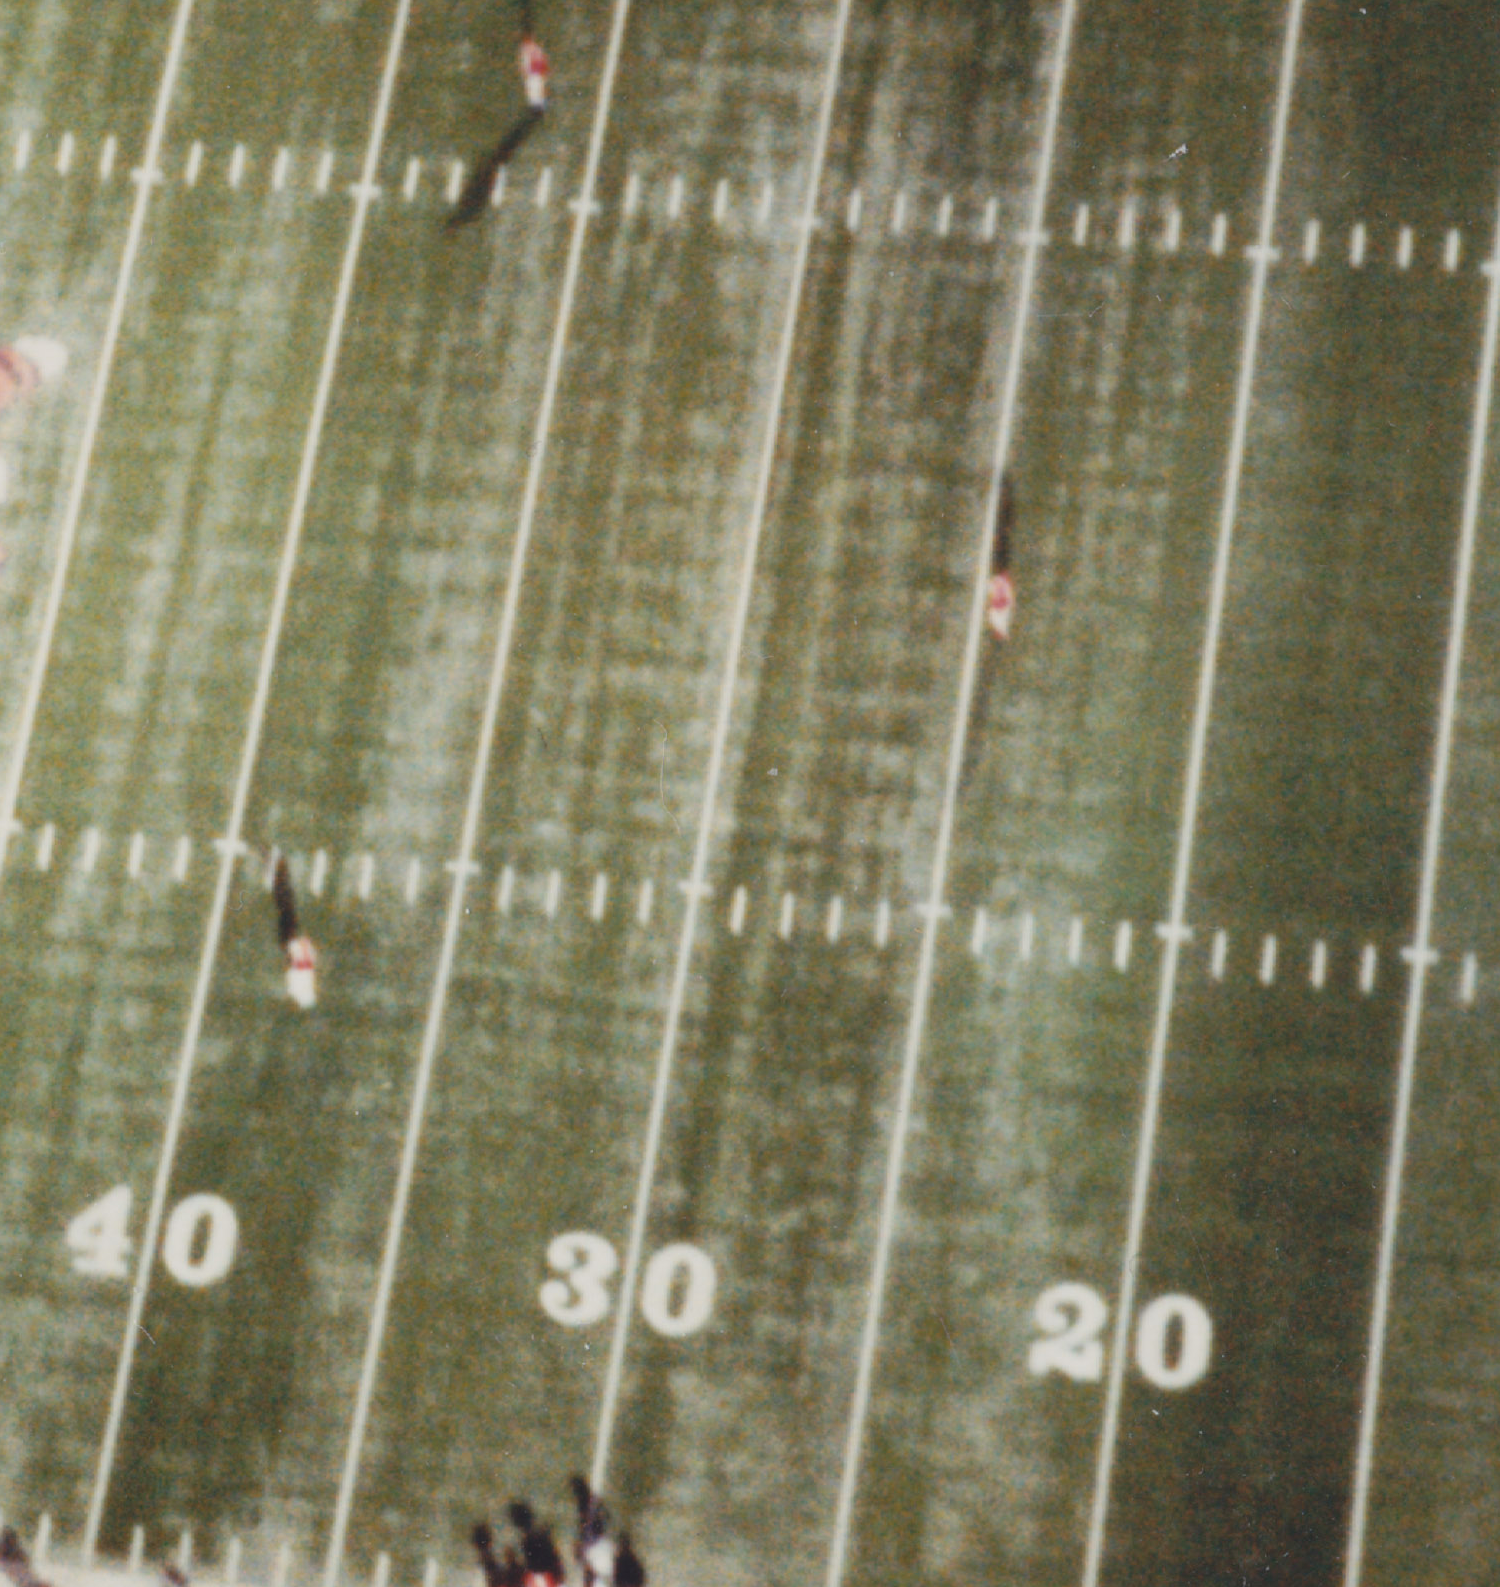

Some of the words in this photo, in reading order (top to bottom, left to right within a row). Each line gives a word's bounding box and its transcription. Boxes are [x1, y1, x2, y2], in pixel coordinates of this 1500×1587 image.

[64, 1183, 241, 1290] 40
[538, 1230, 718, 1338] 30
[1027, 1281, 1214, 1389] 20
